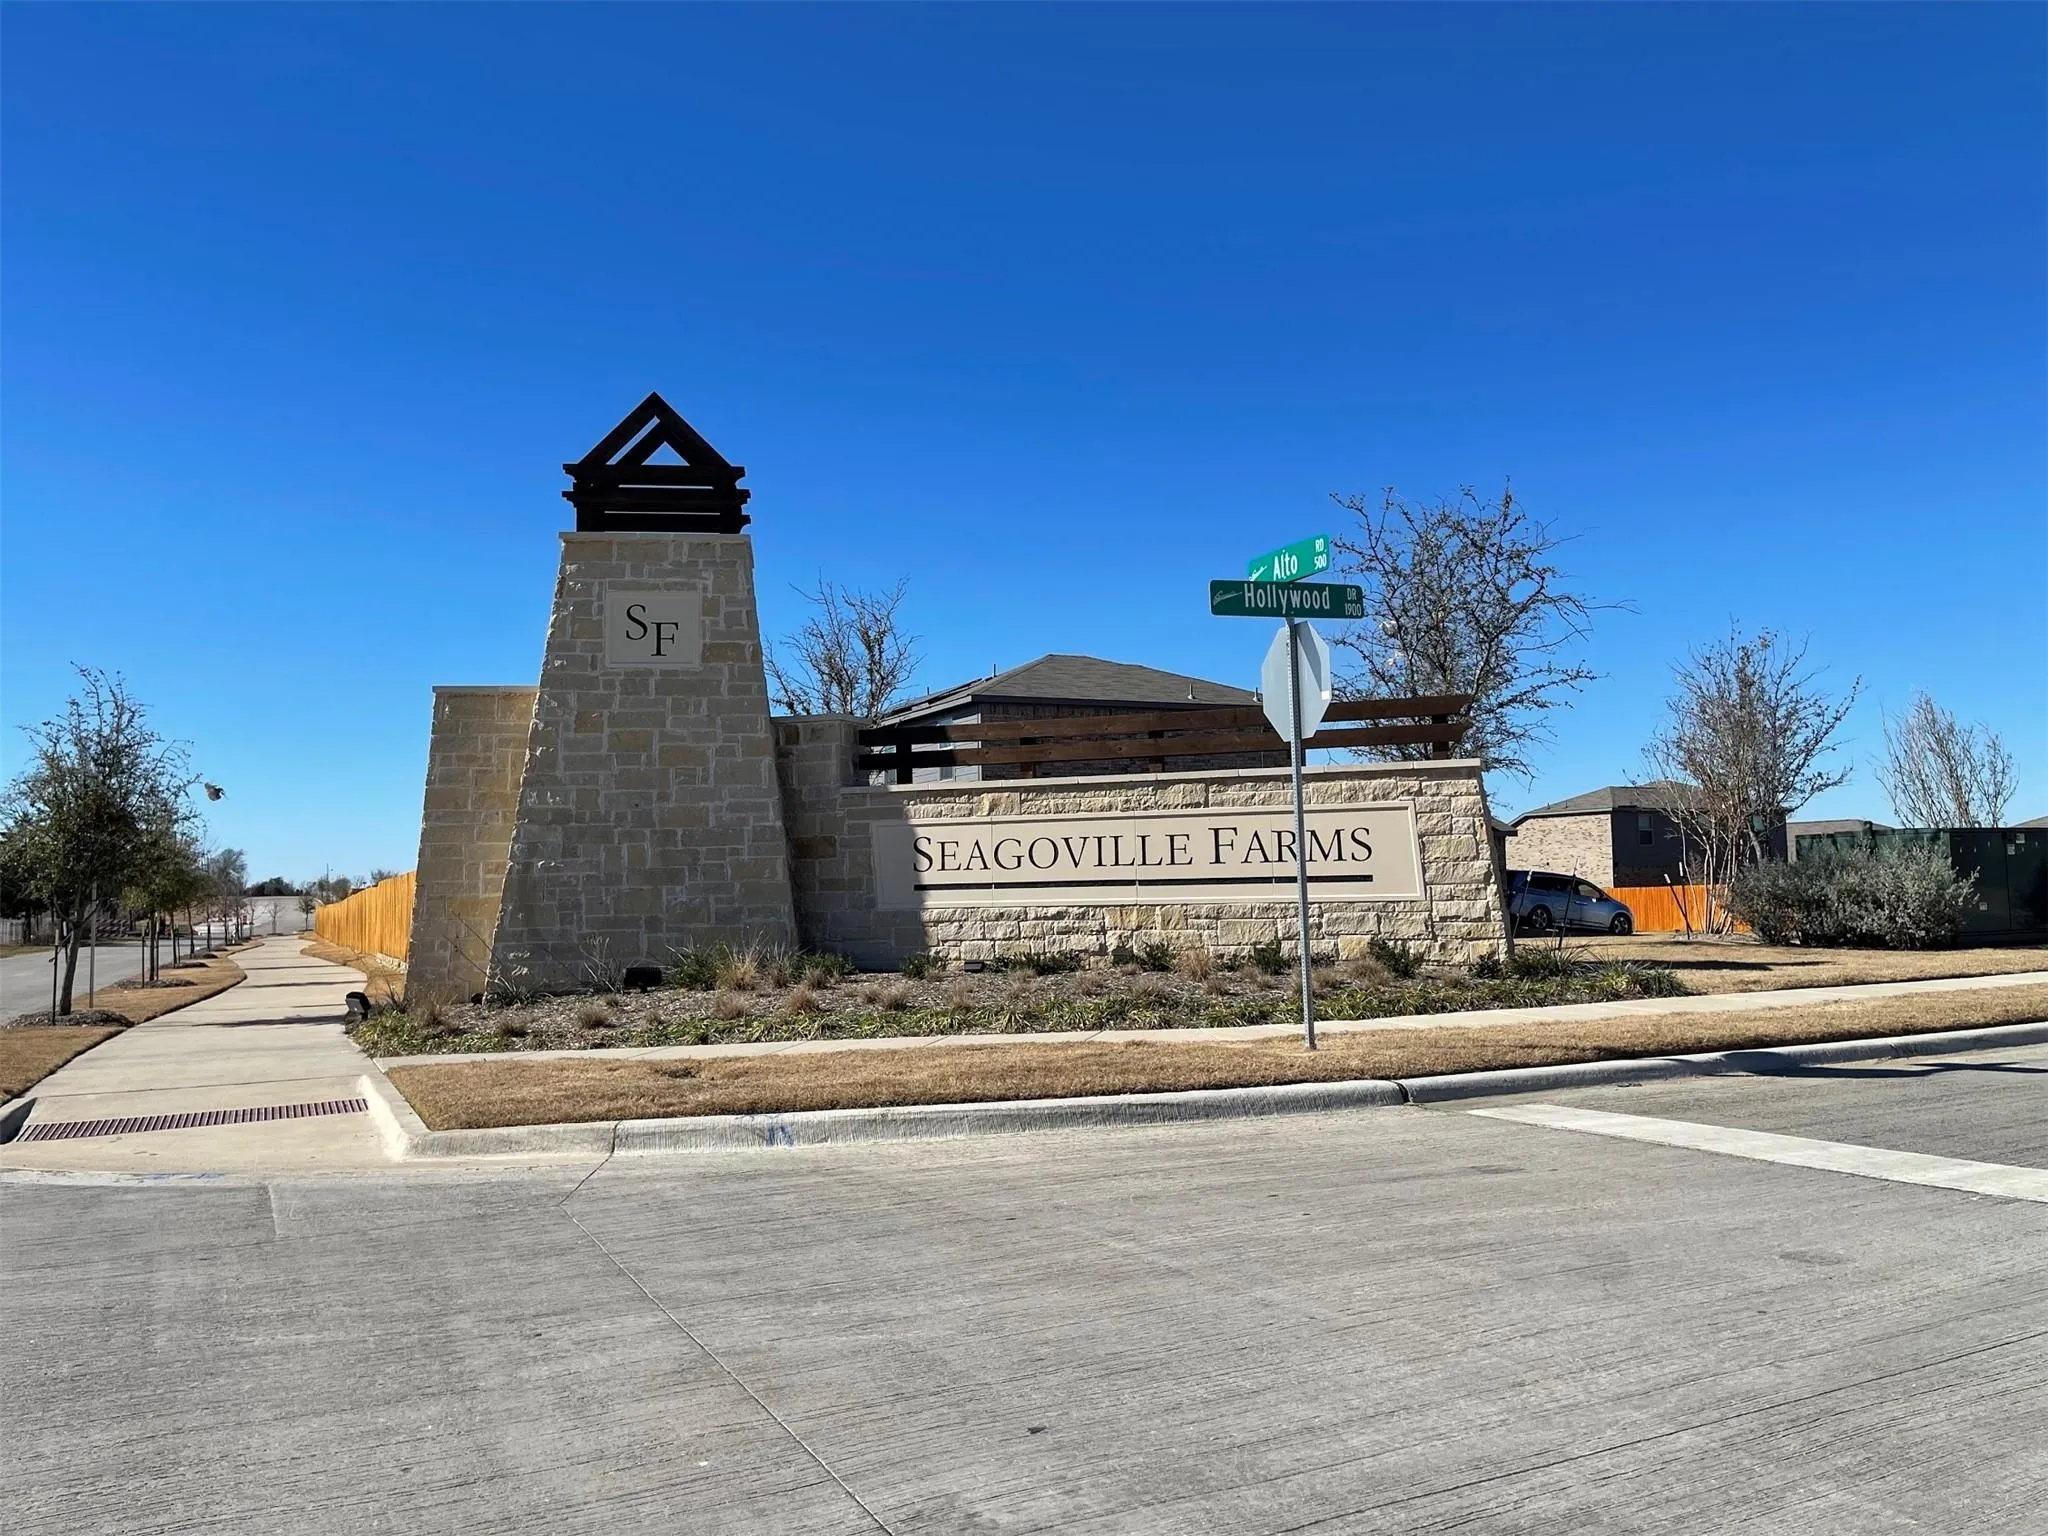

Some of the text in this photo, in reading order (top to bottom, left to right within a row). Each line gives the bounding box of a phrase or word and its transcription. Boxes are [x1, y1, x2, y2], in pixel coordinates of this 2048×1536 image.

[1273, 551, 1298, 581] Alto
[1314, 553, 1327, 570] 500
[1244, 583, 1330, 615] Hollywood
[1347, 588, 1357, 600] DR
[1345, 603, 1362, 616] 1900
[913, 826, 1374, 873] SEAGOVILLE FARMS
